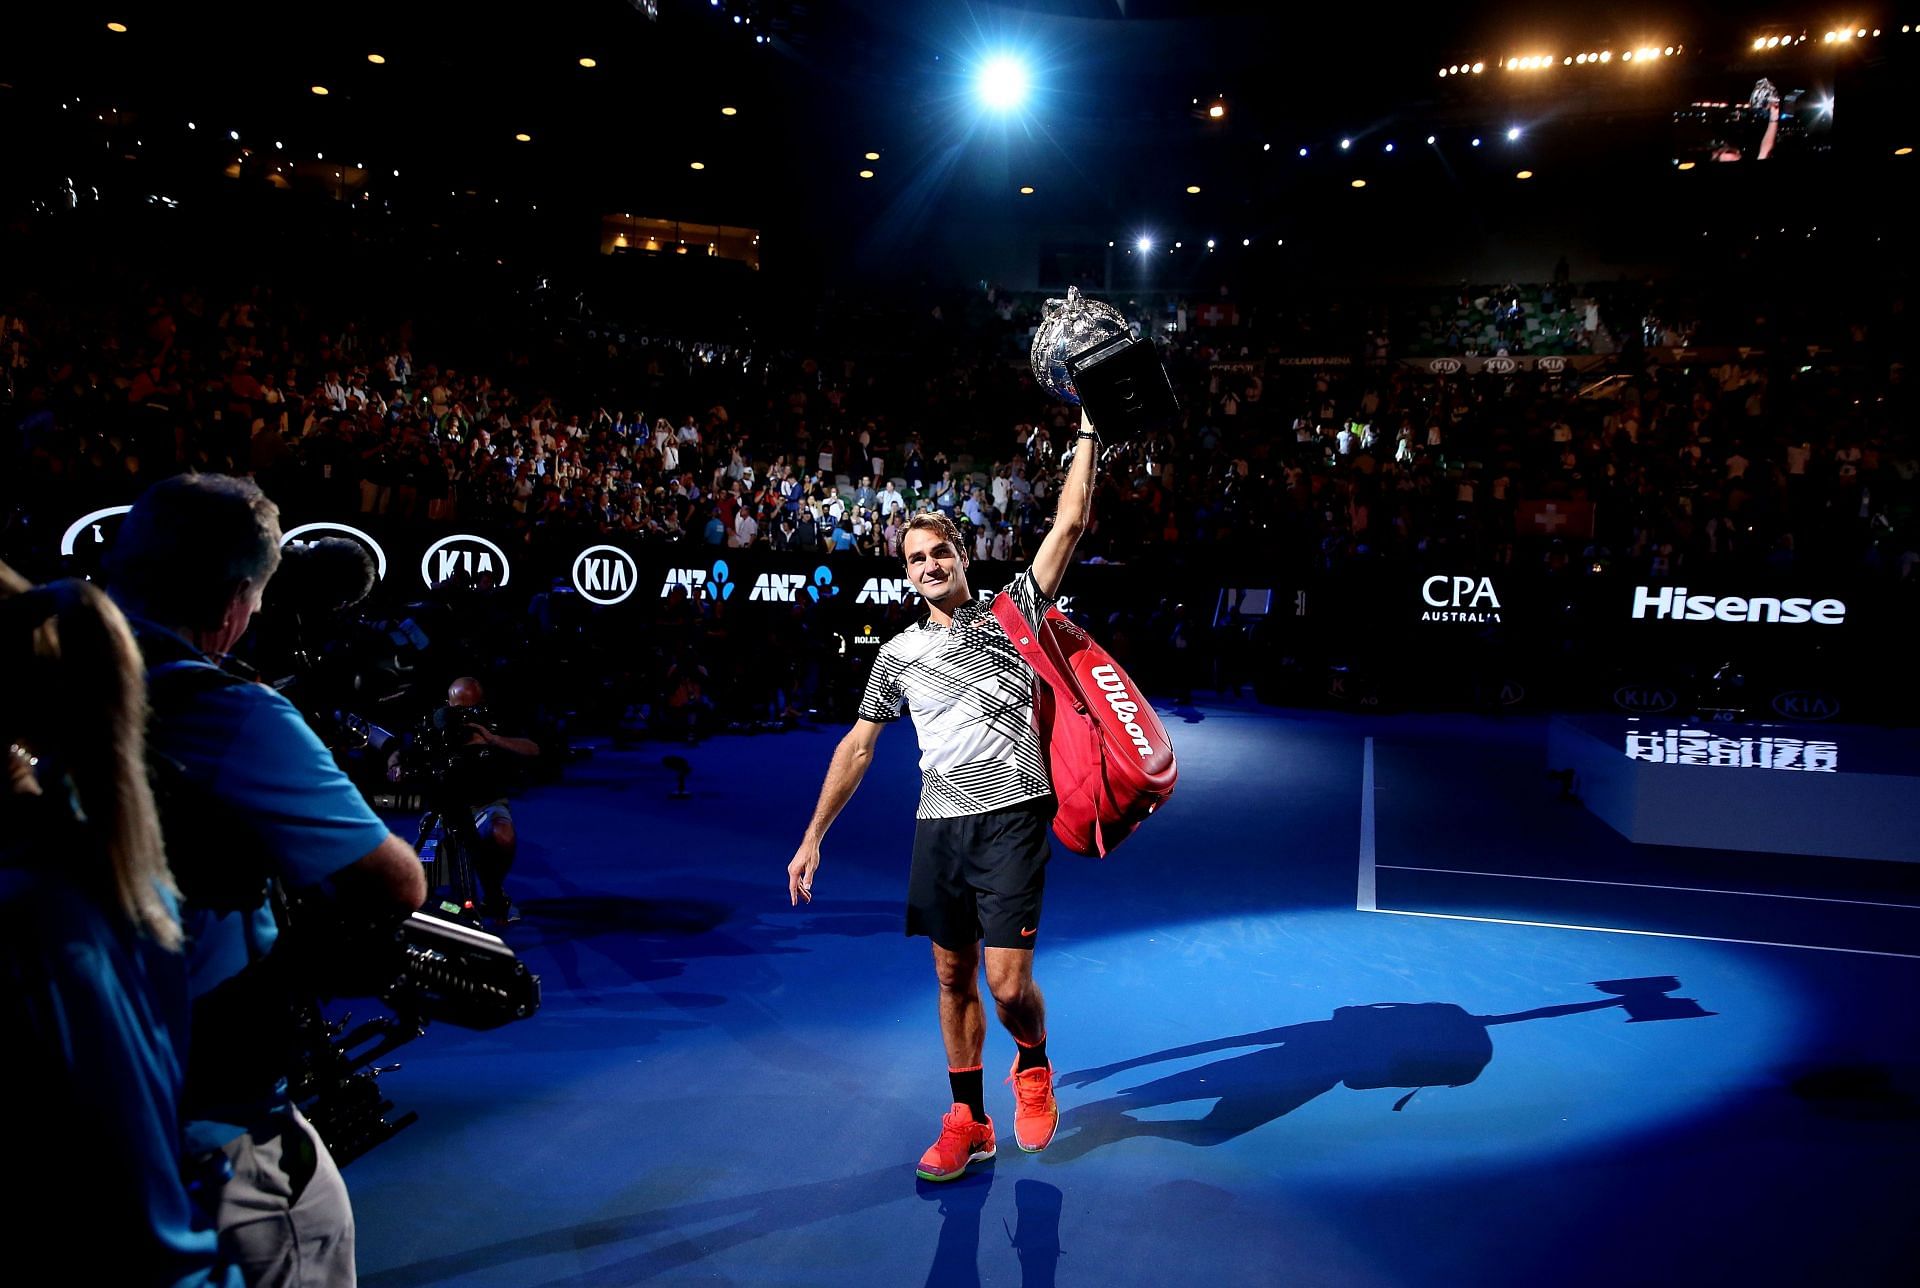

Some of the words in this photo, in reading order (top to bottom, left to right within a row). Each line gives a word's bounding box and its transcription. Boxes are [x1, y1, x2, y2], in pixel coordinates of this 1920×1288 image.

[585, 558, 627, 591] KIA
[749, 573, 807, 601] ANZ
[1421, 574, 1501, 608] CPA
[1631, 585, 1847, 625] Hisense
[854, 635, 881, 645] ROLEX
[1091, 663, 1154, 757] Wilson
[1625, 690, 1666, 706] KIA
[1783, 695, 1825, 714] KIA
